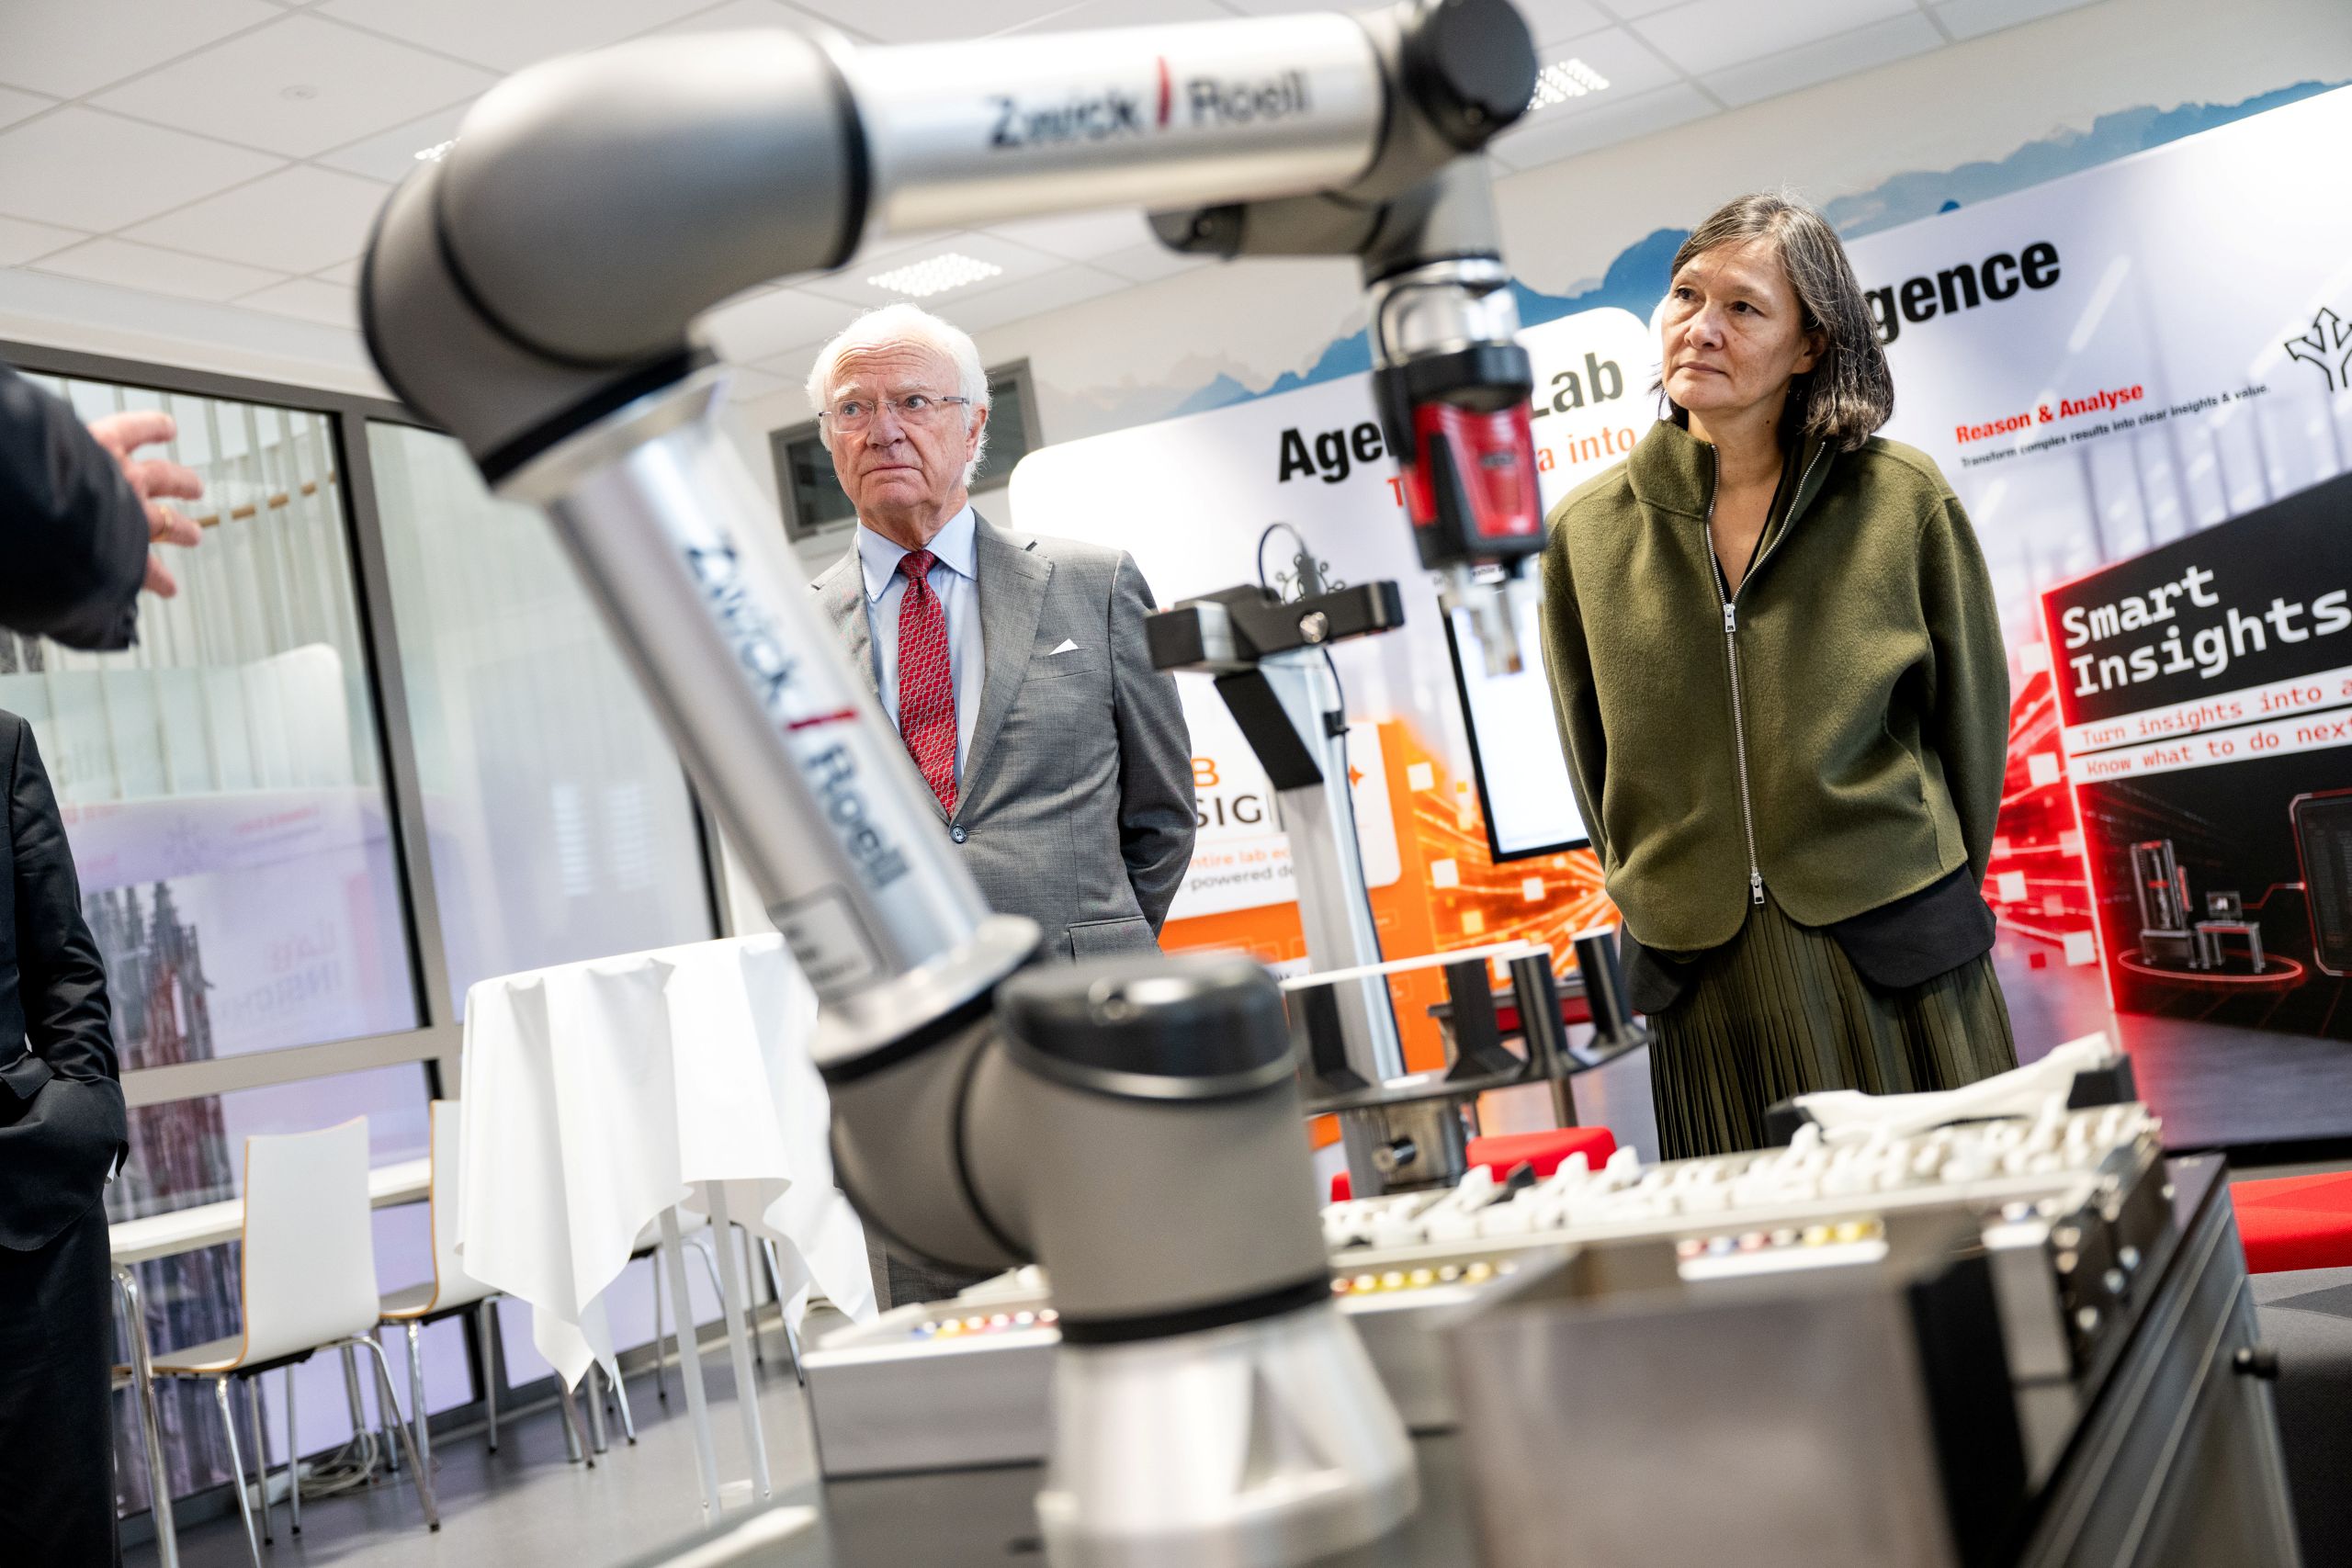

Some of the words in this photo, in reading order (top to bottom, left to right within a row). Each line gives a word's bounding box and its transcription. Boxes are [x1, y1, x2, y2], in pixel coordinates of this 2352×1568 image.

[1567, 426, 1636, 464] into
[1955, 412, 2031, 445] Reason
[2038, 404, 2054, 423] &
[2060, 383, 2143, 419] Analyse
[1962, 446, 2017, 468] Transform
[2020, 435, 2066, 456] complex
[2070, 423, 2110, 443] results
[2113, 419, 2135, 432] into
[2139, 411, 2167, 425] clear
[2171, 396, 2219, 416] insights
[2221, 391, 2231, 402] &
[2062, 565, 2220, 649] Smart
[2069, 589, 2352, 698] Insights
[2083, 727, 2127, 747] Turn
[2138, 700, 2244, 735] insights
[2261, 686, 2323, 713] into
[2086, 759, 2132, 777] Know
[2143, 746, 2193, 768] what
[2206, 738, 2234, 758] to
[2249, 729, 2279, 750] do
